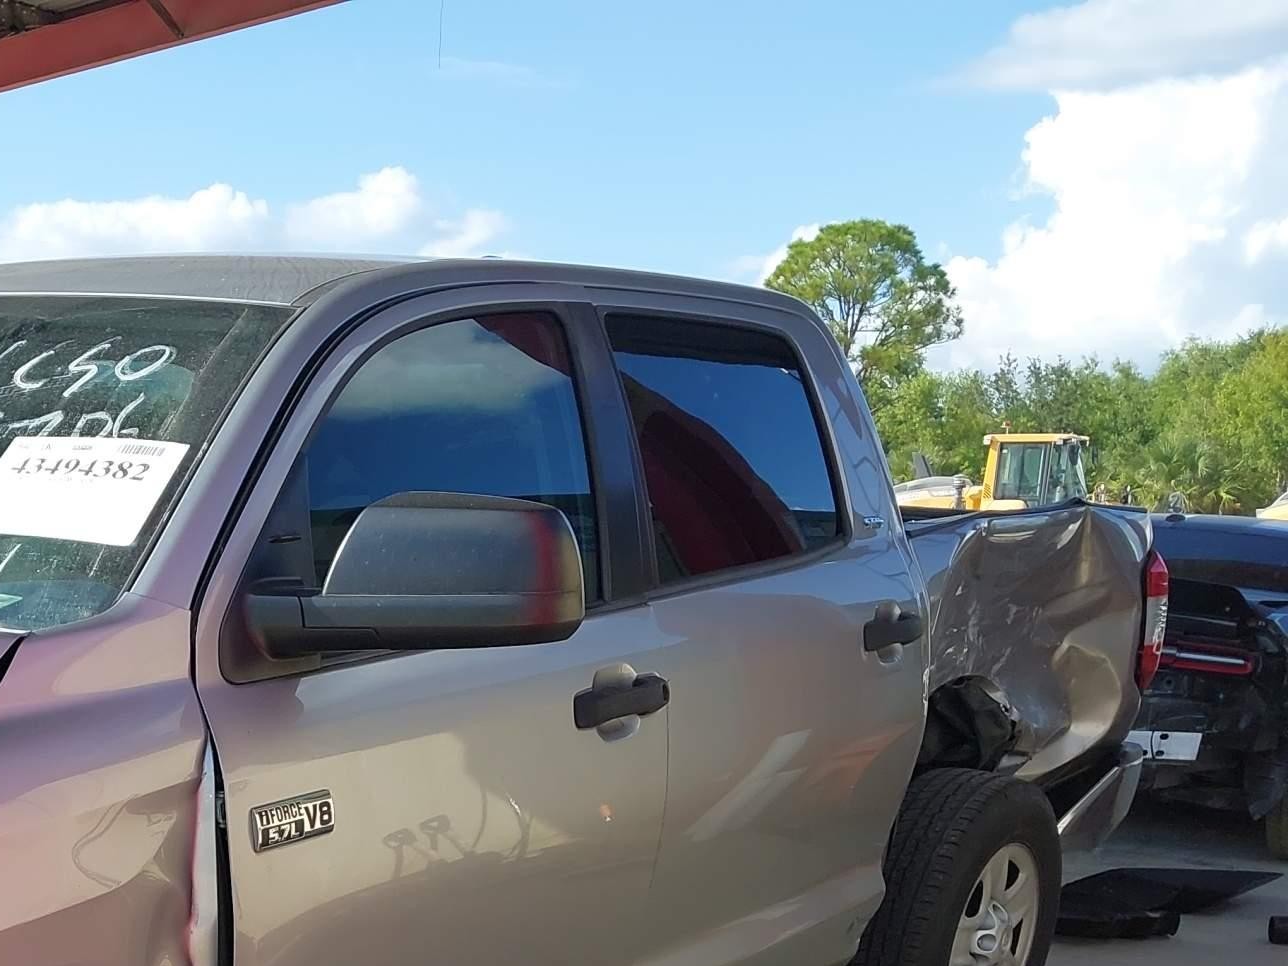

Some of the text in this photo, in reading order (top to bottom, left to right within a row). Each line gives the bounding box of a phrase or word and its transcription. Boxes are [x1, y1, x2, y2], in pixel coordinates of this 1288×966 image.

[11, 457, 151, 481] 43494382
[303, 800, 333, 829] V8
[268, 822, 301, 845] 5.7L
